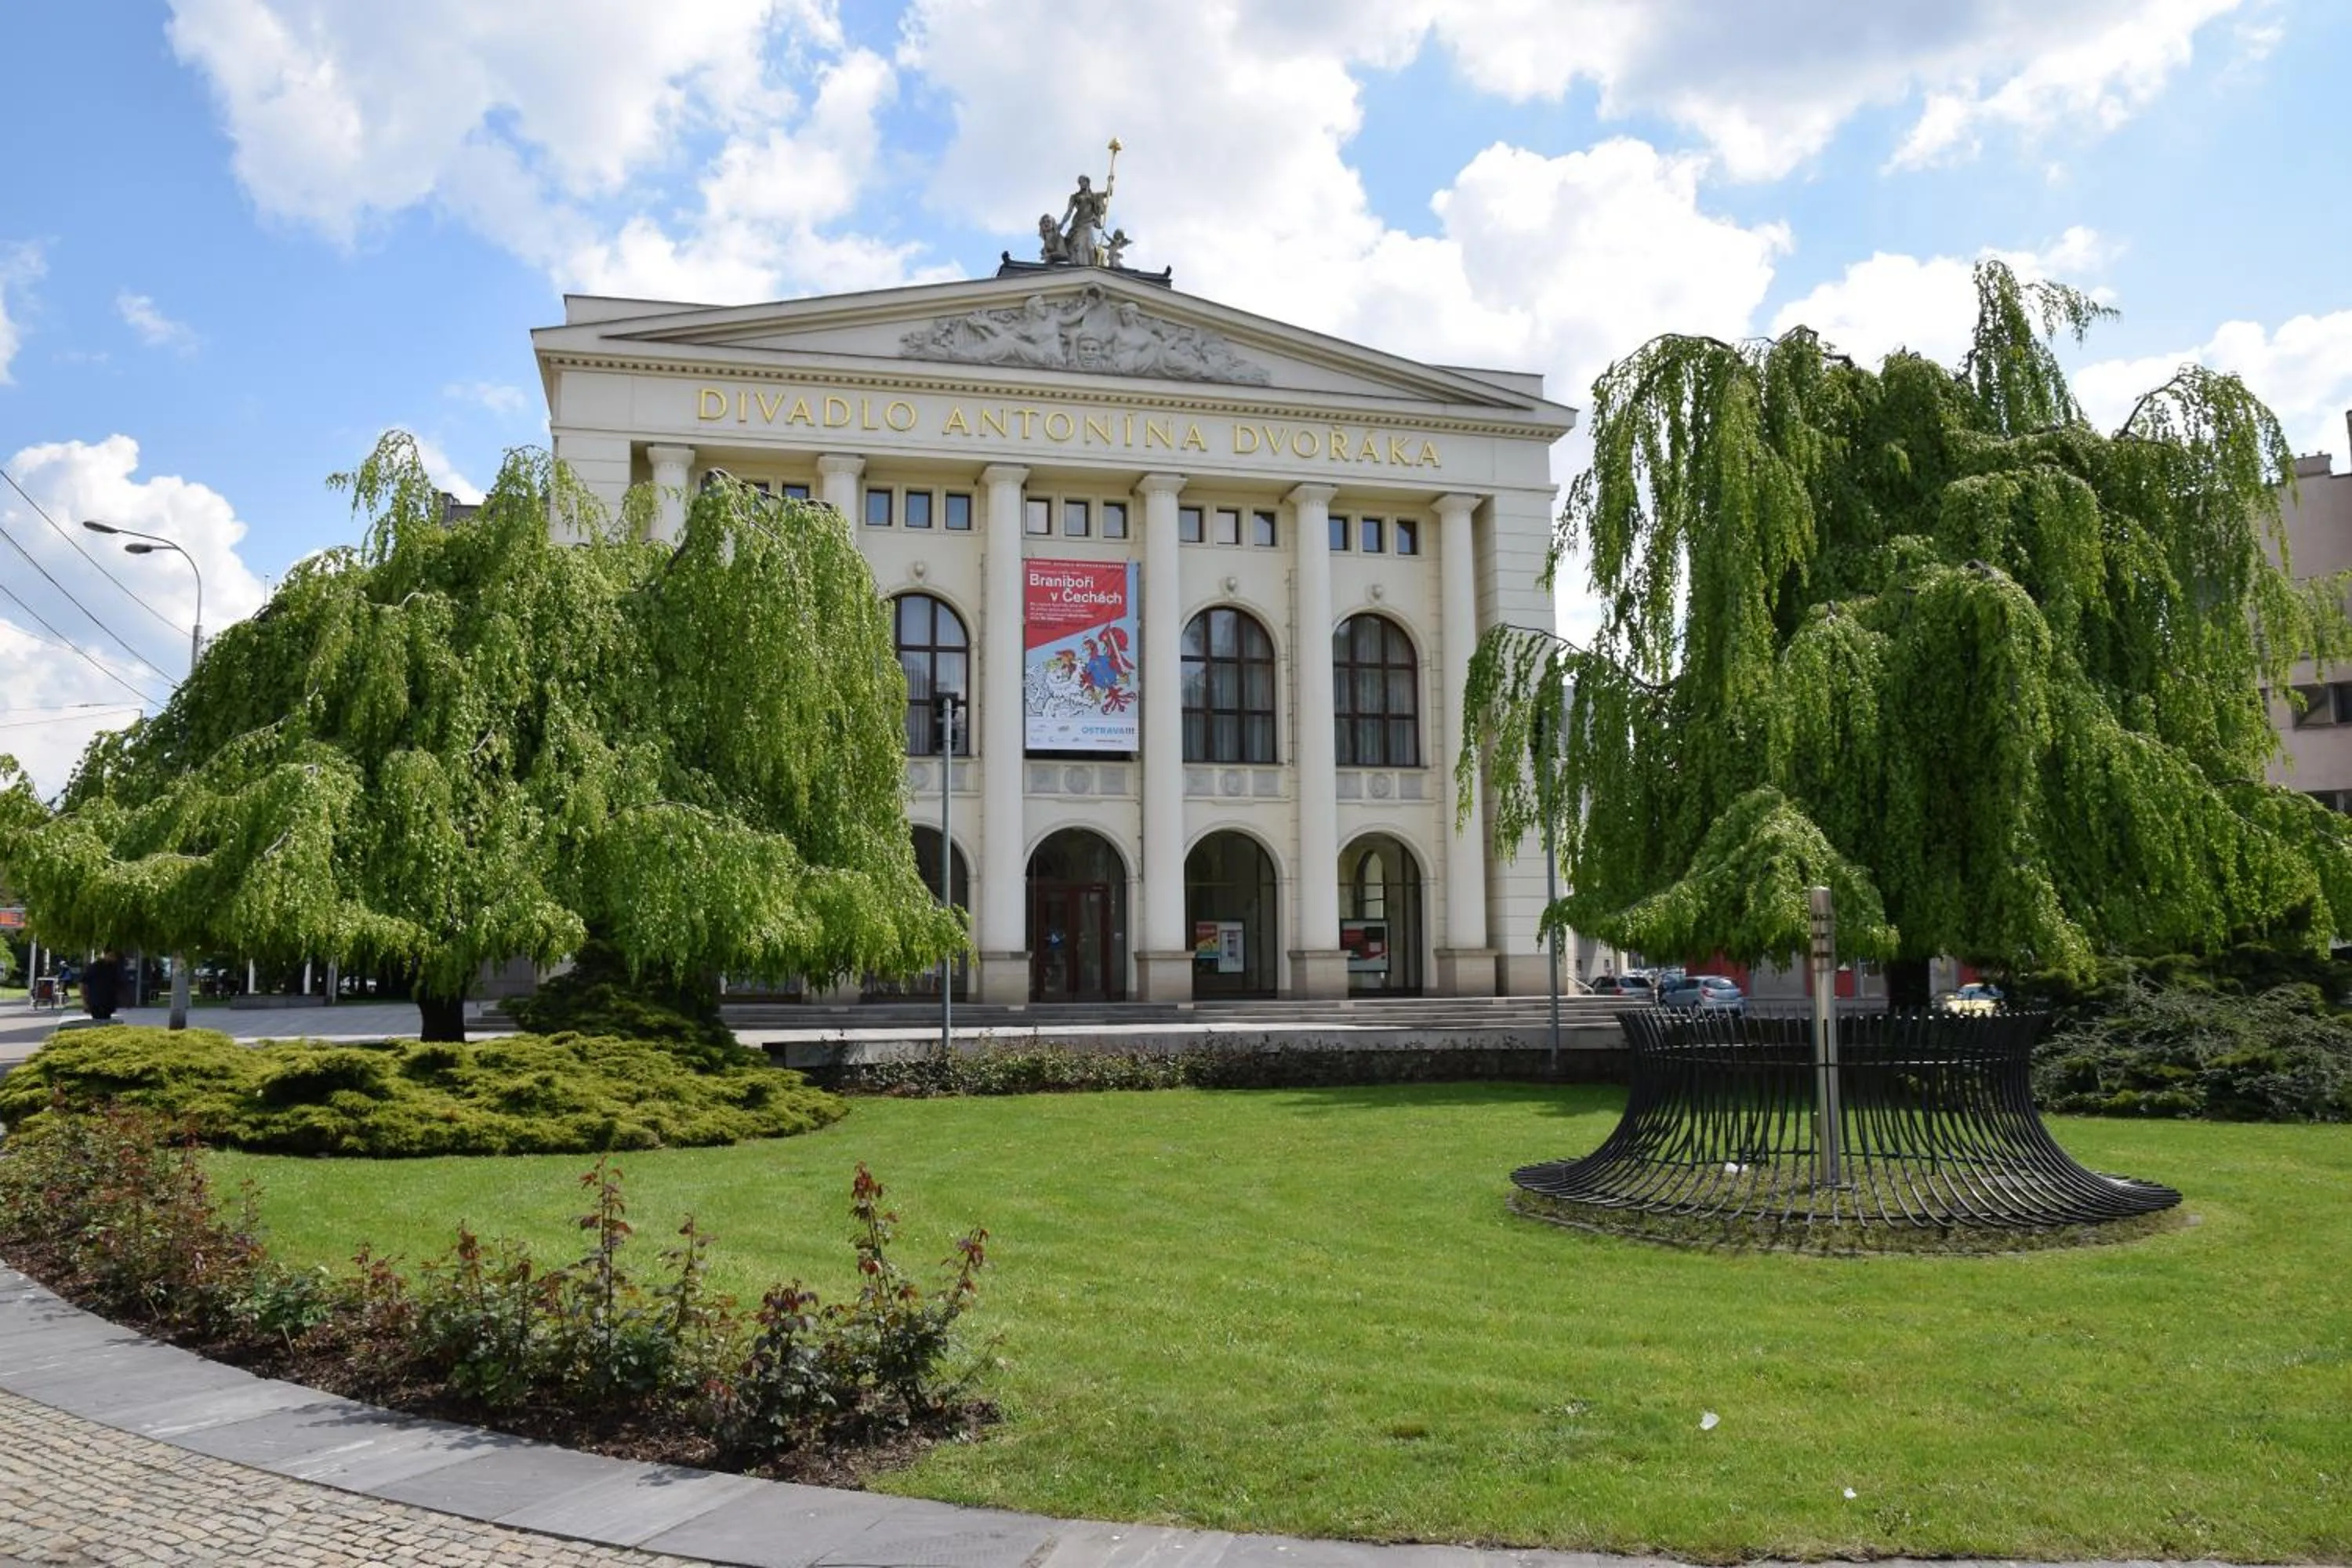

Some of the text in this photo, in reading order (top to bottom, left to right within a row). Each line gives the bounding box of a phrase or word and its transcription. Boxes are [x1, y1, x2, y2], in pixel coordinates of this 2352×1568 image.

[698, 389, 917, 431] DIVADLO
[1029, 573, 1094, 588] Braniboři
[1051, 588, 1122, 604] v Čechách
